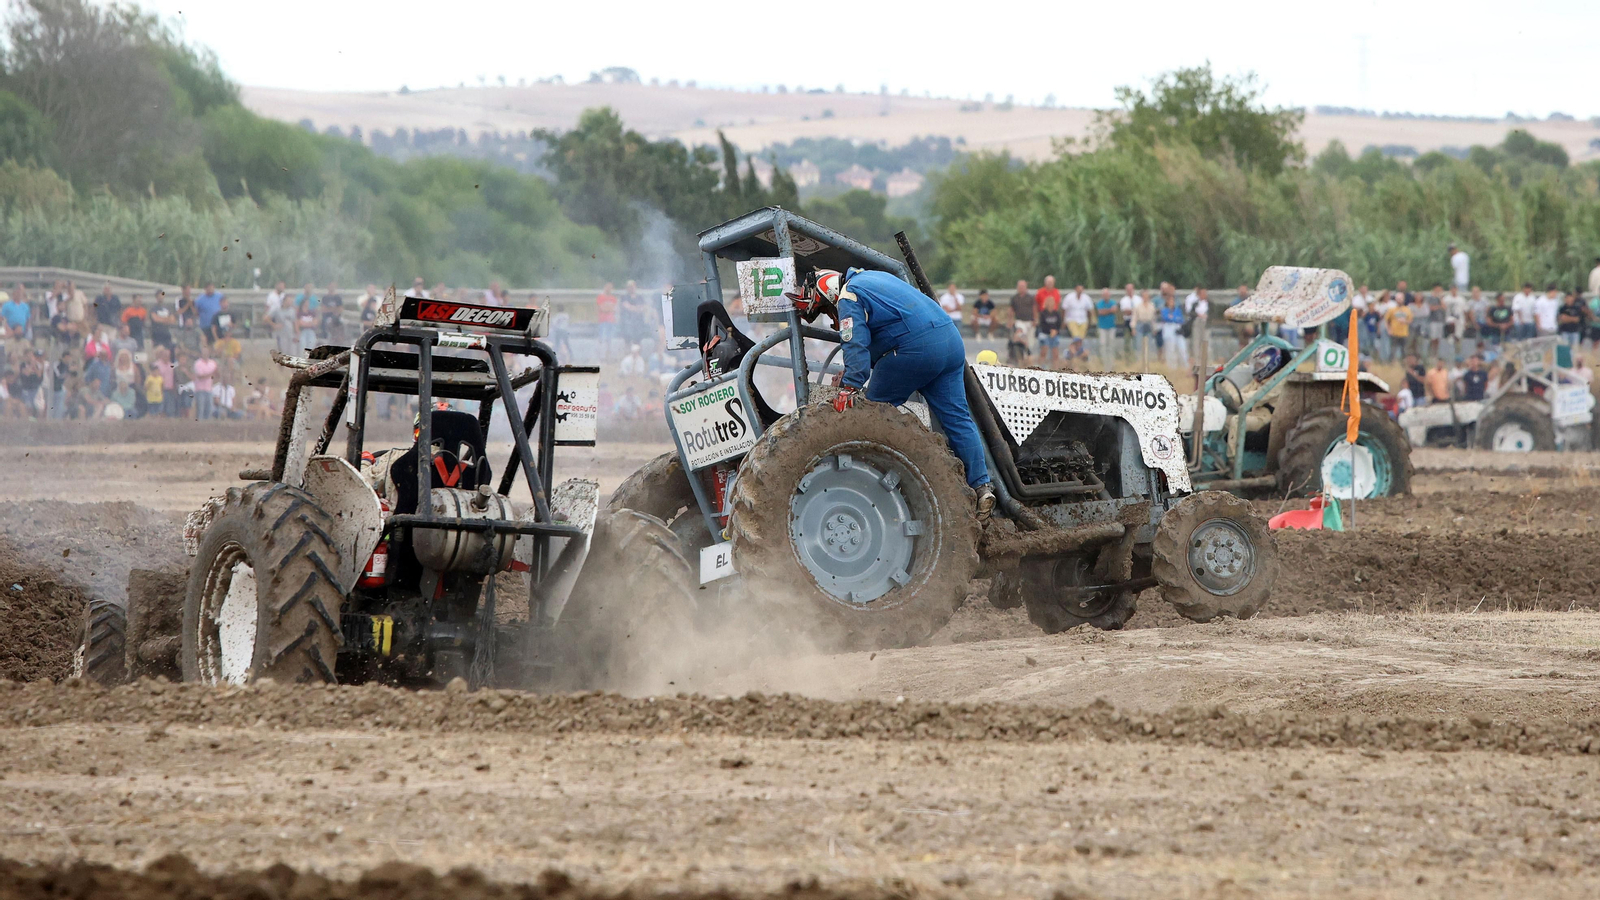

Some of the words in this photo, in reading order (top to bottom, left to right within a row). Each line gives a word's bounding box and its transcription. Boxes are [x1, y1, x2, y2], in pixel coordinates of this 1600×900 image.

[750, 267, 783, 300] 12
[1324, 348, 1346, 368] 01
[680, 399, 697, 414] SOY
[698, 386, 735, 408] ROCIERO
[987, 372, 1040, 395] TURBO
[1045, 379, 1096, 401] DIESEL
[1100, 384, 1167, 410] CAMPOS
[715, 553, 728, 569] EL
